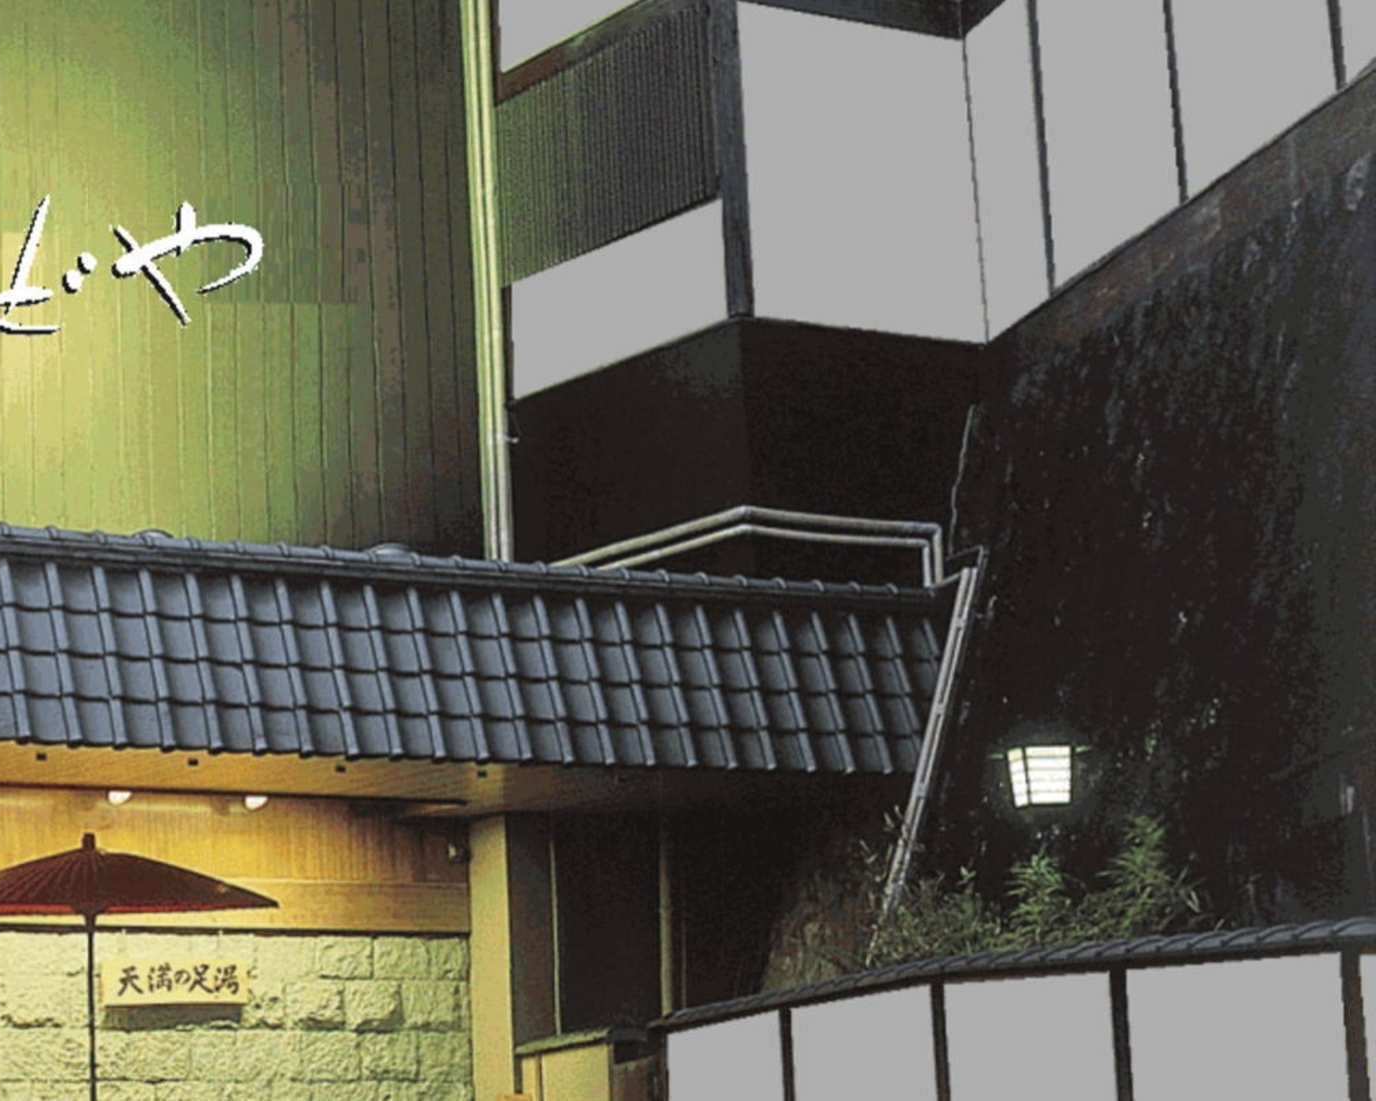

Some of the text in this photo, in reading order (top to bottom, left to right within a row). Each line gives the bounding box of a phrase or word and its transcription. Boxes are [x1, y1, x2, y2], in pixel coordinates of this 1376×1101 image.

[118, 962, 240, 997] 天満の足湯
